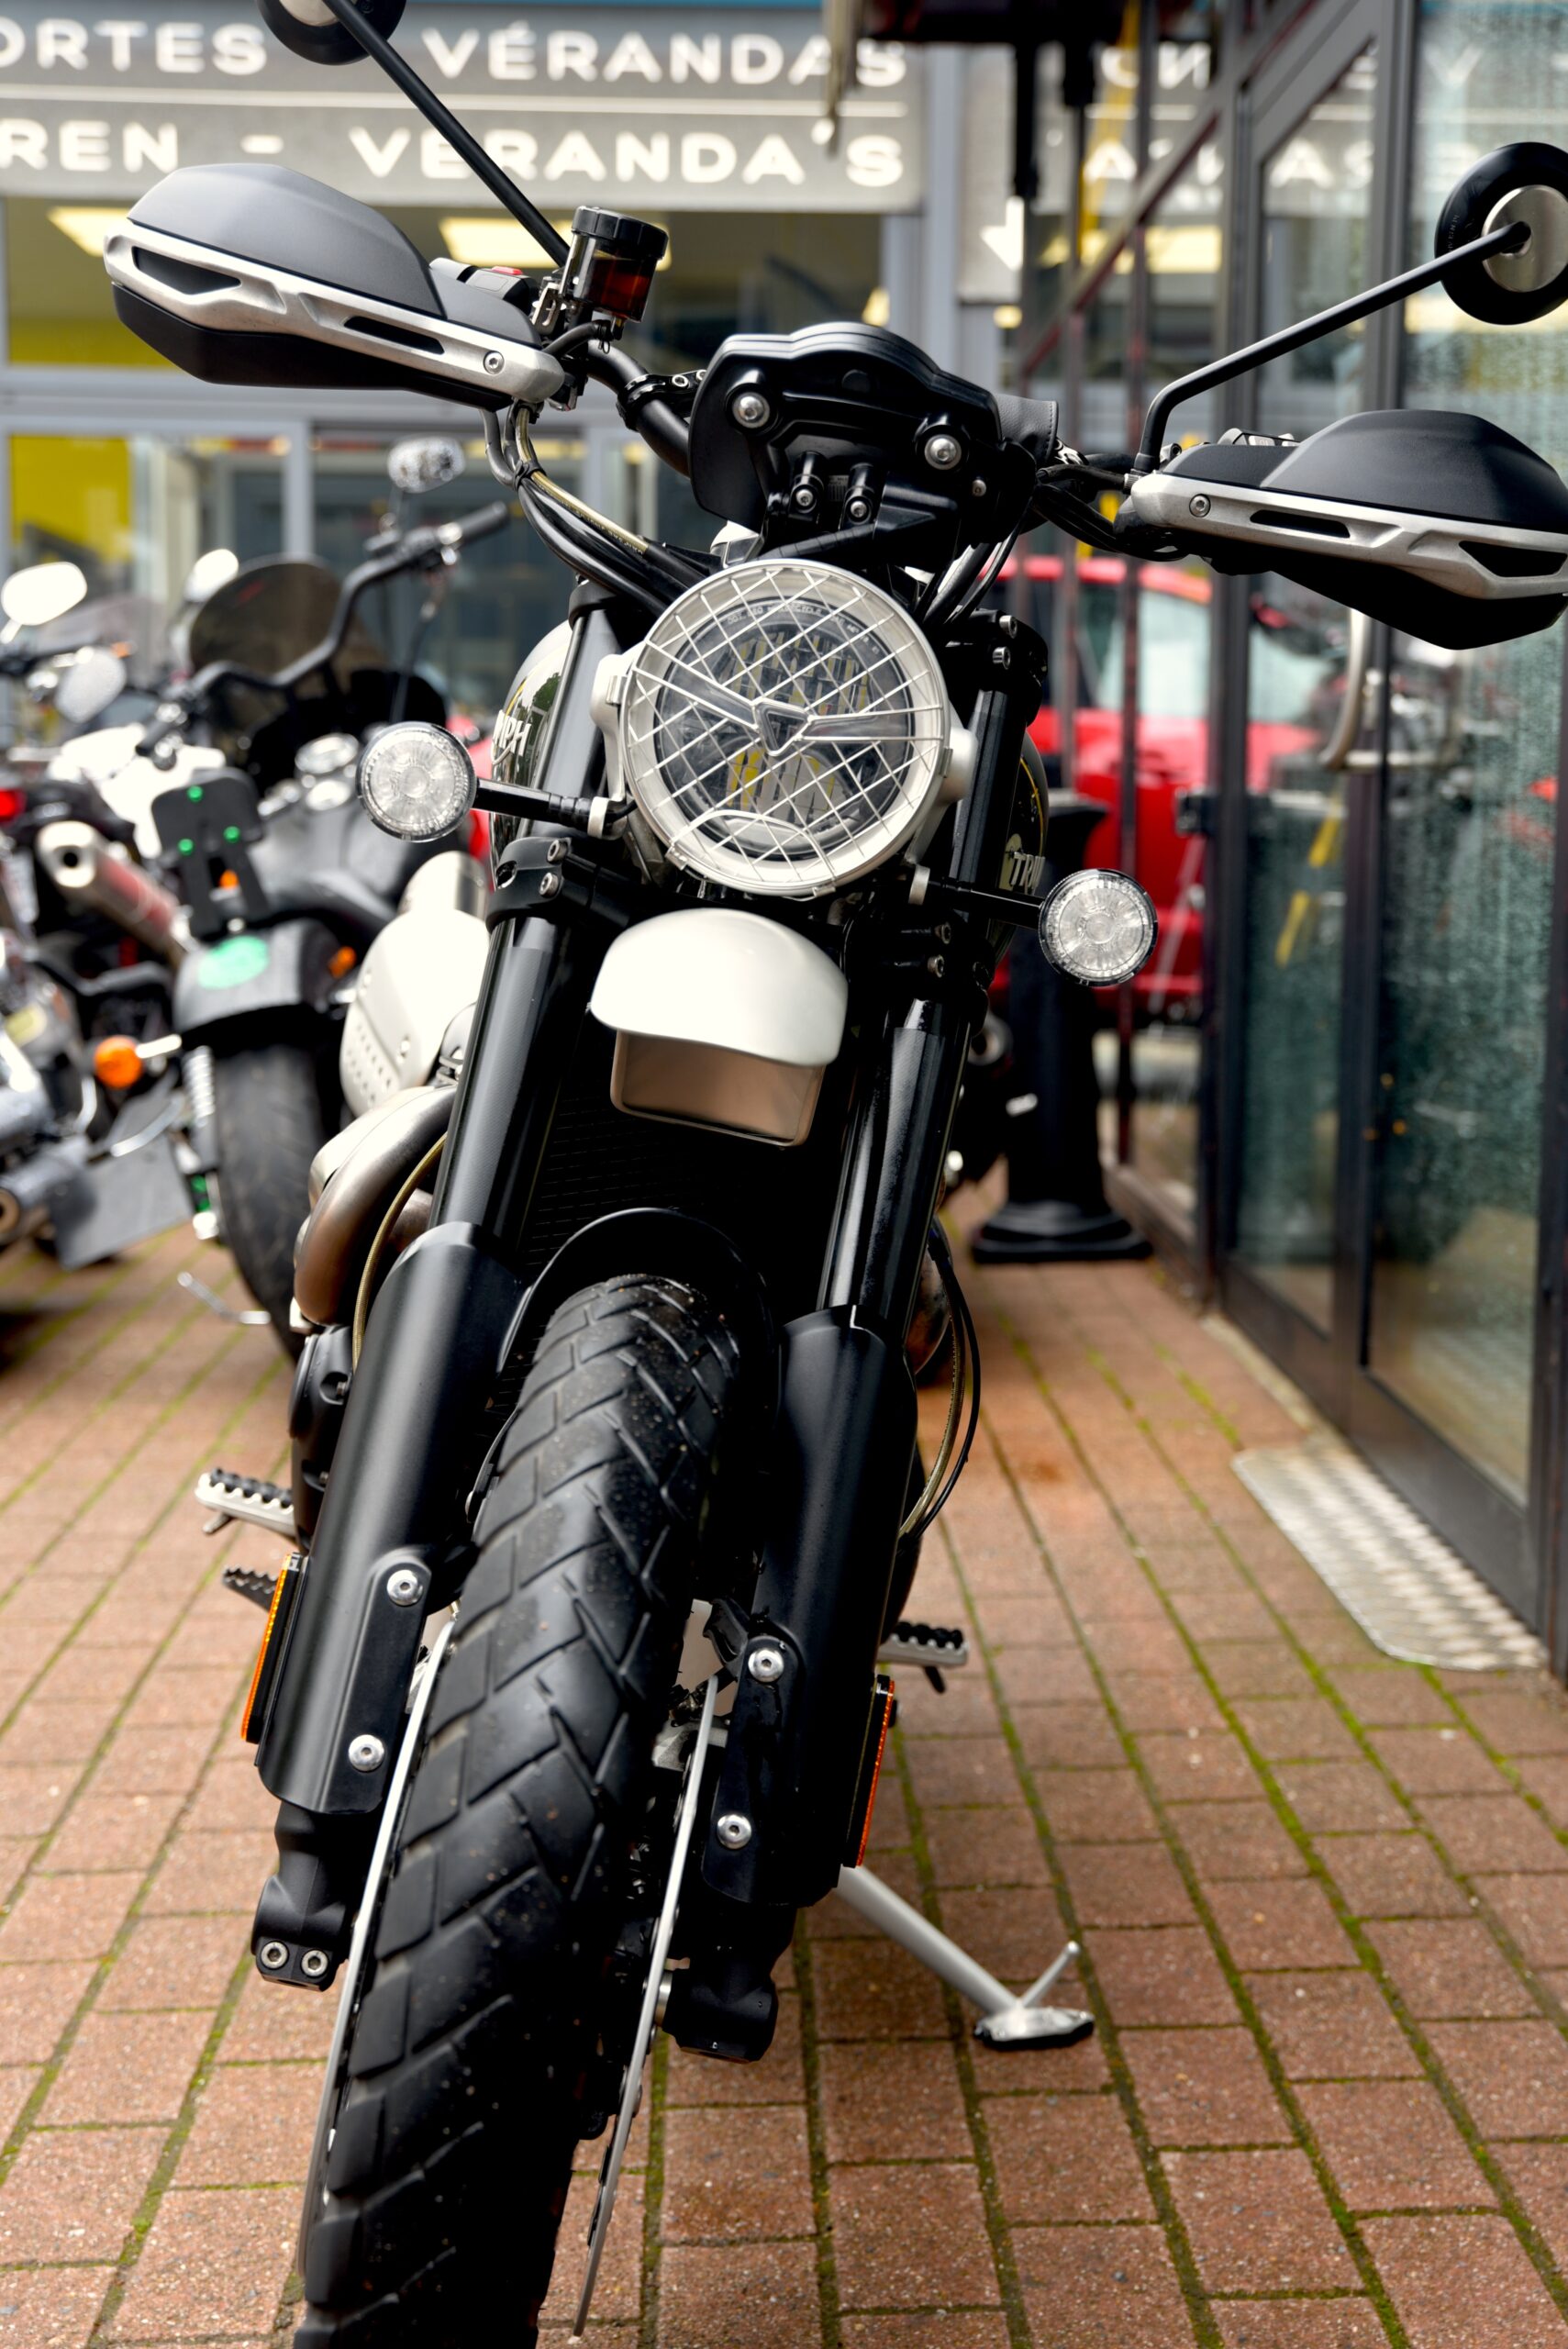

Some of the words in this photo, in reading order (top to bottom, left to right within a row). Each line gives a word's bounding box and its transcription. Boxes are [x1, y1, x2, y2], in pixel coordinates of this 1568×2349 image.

[422, 20, 906, 87] VÉRANDAS
[0, 117, 178, 173] REN
[348, 118, 904, 187] VERANDA'S
